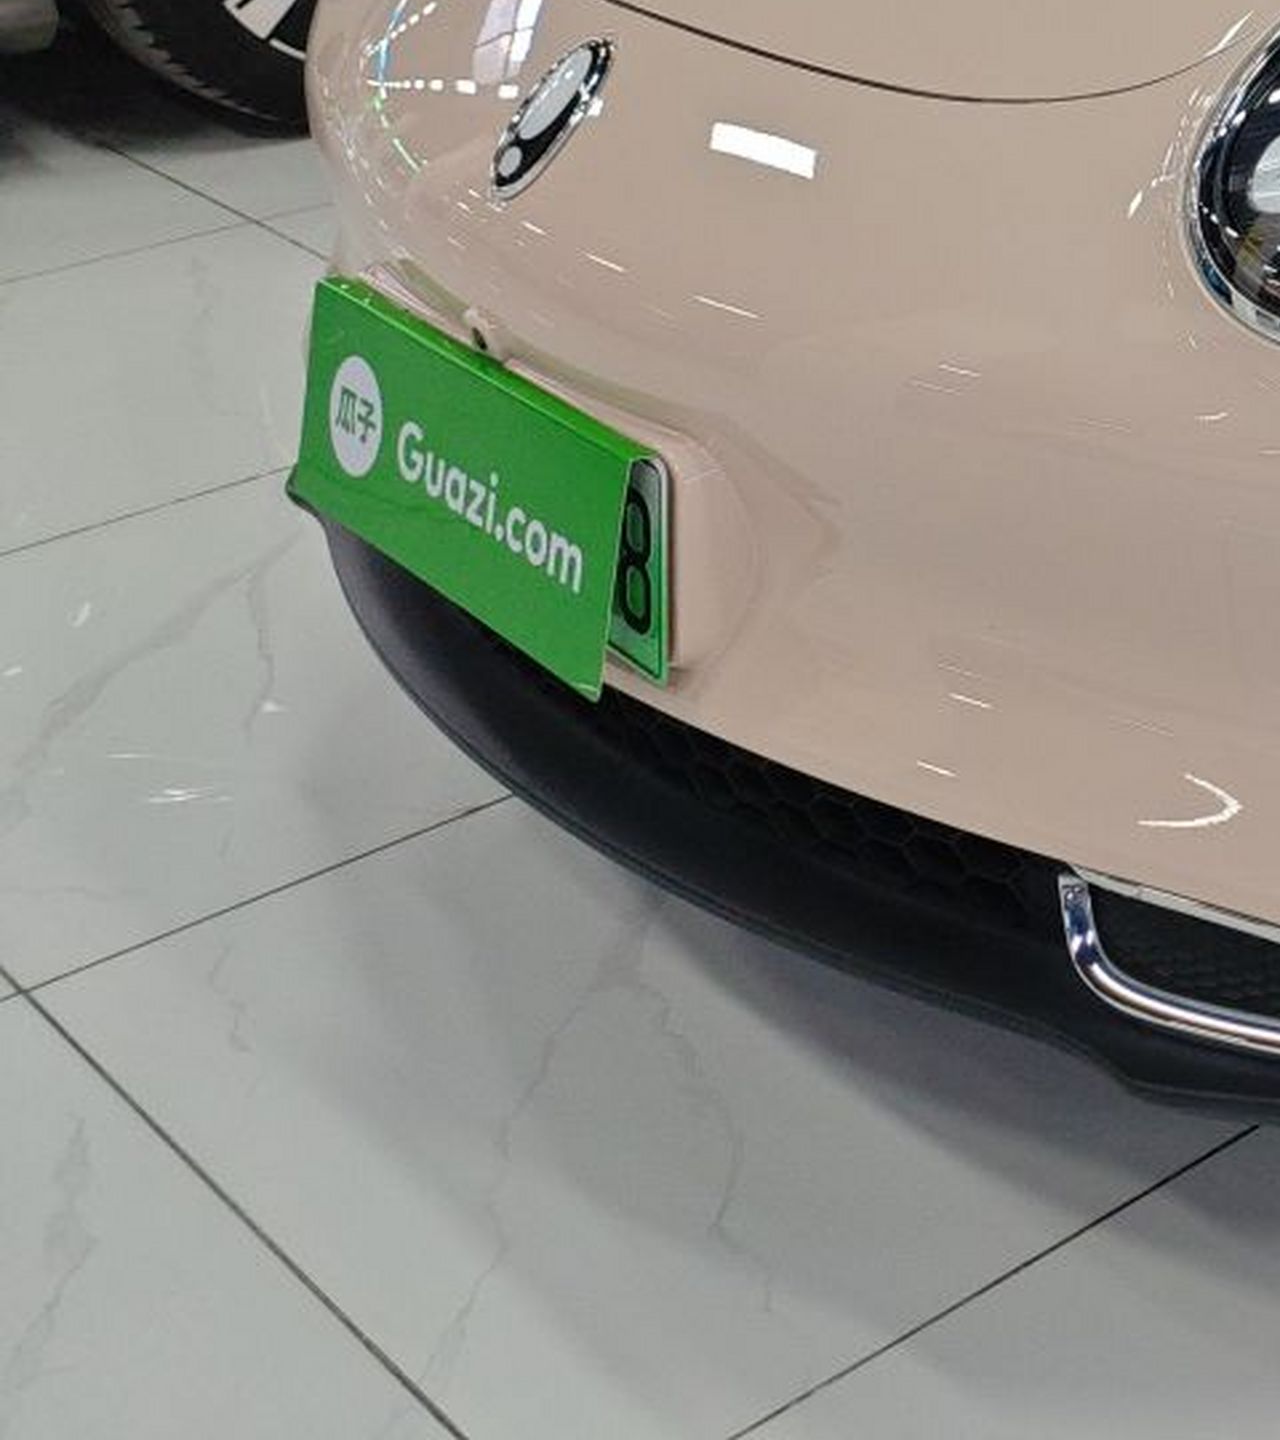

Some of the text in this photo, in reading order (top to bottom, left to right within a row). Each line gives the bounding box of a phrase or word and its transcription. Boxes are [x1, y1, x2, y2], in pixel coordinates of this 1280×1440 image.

[334, 384, 377, 444] 瓜子
[397, 421, 583, 594] Guazi.com
[618, 488, 652, 636] 8
